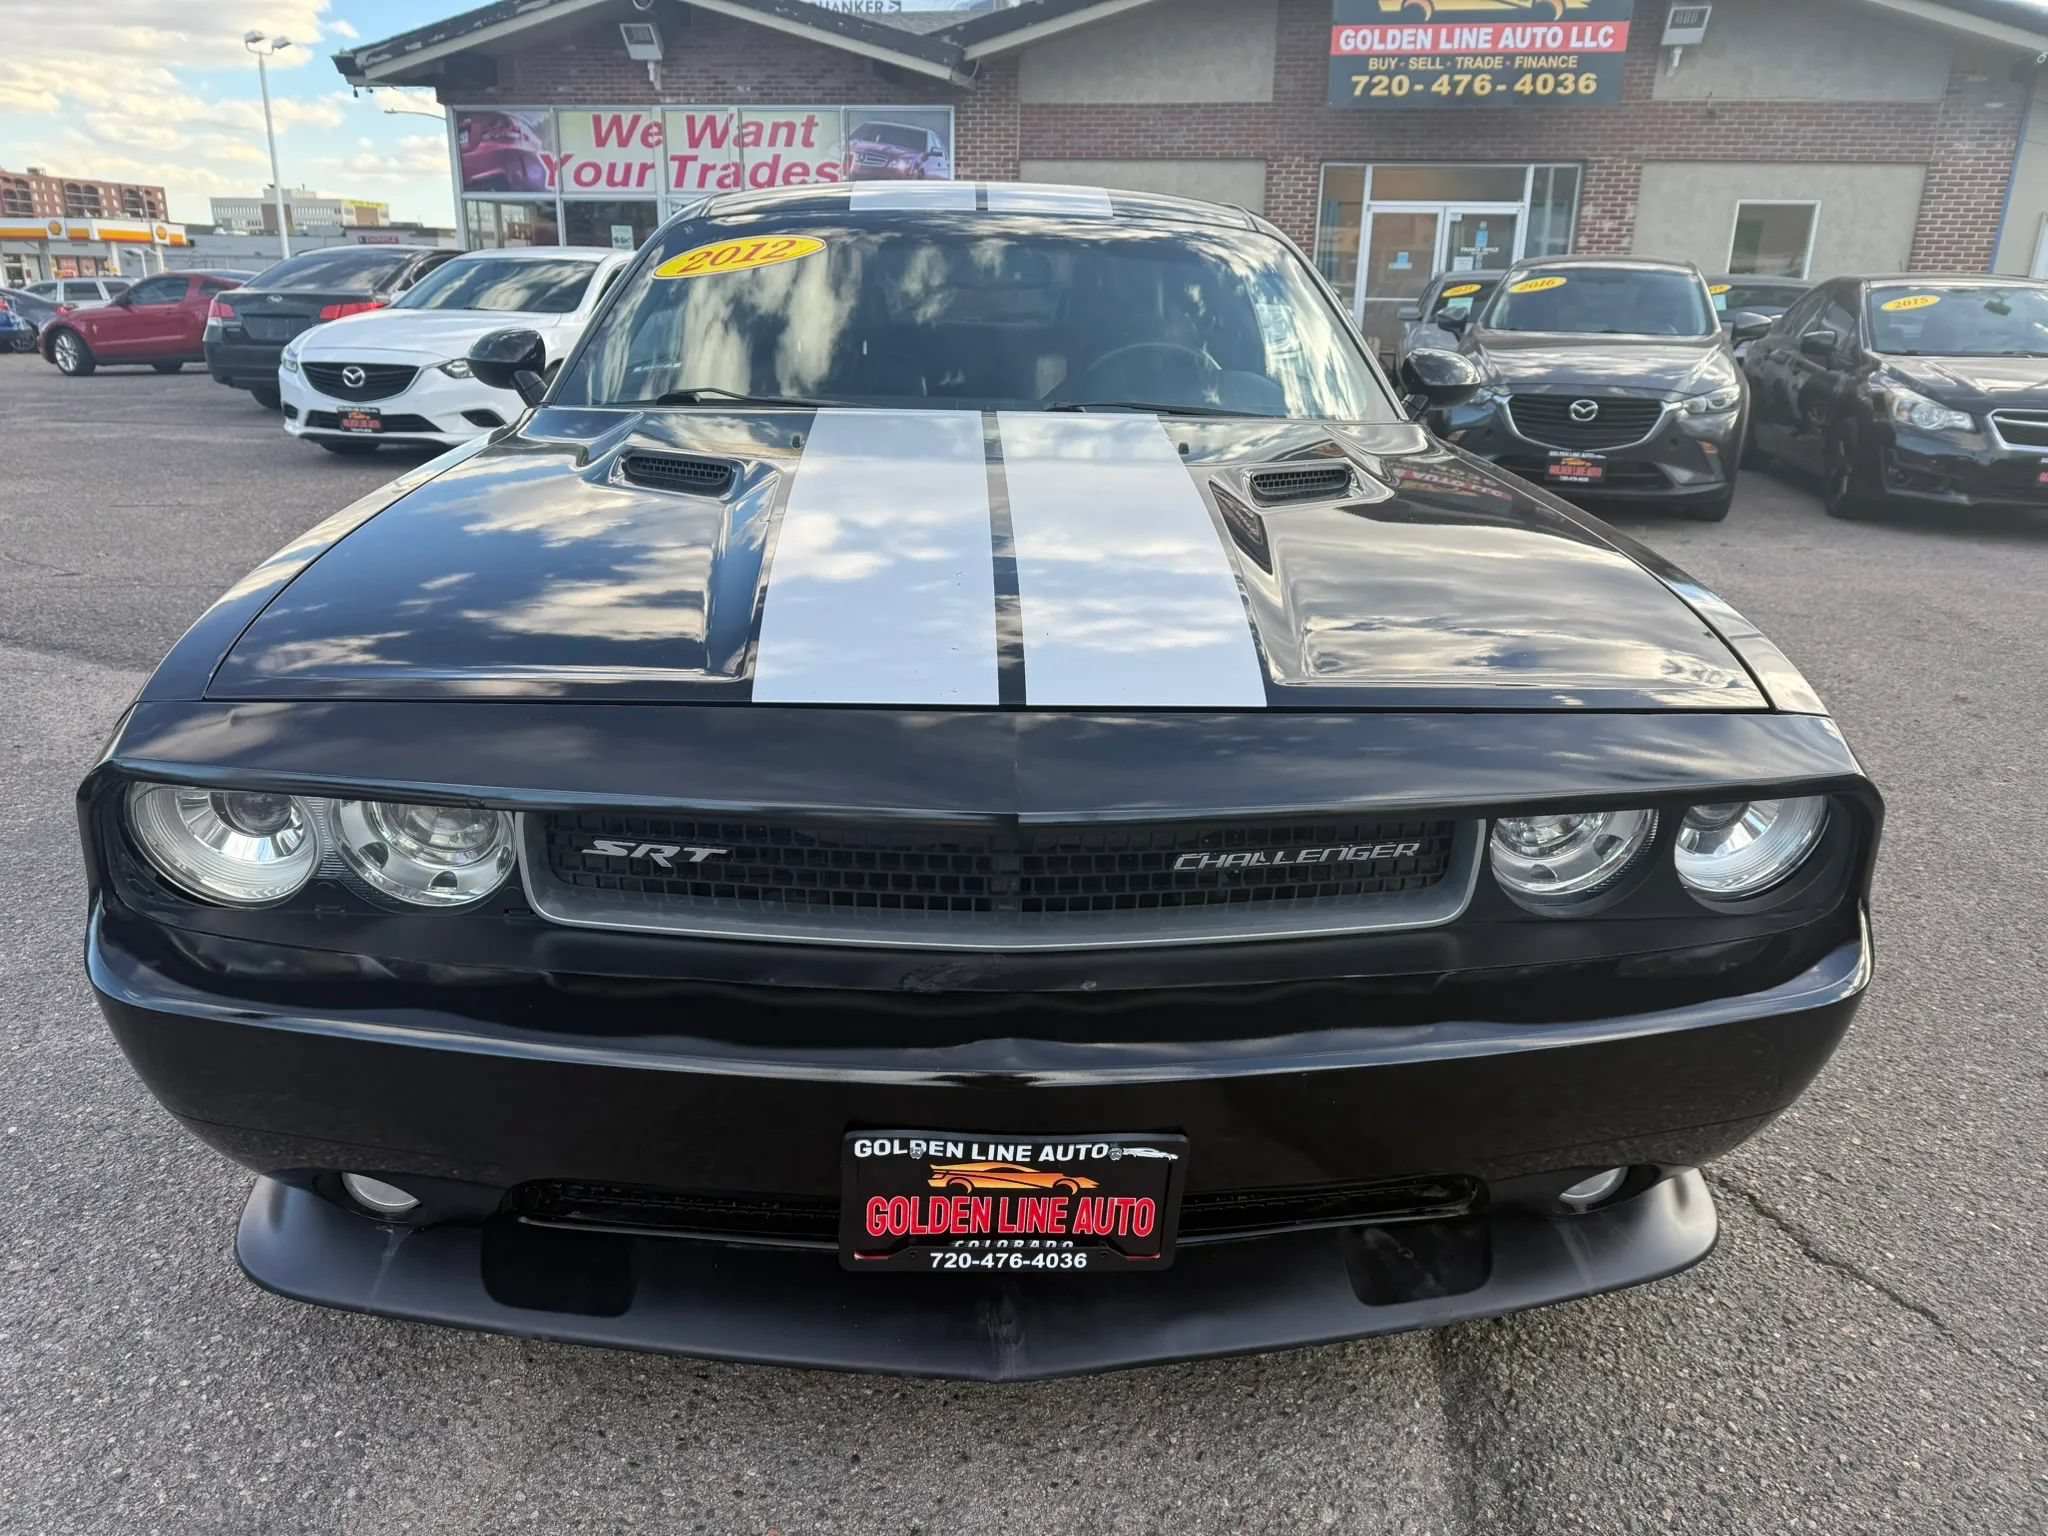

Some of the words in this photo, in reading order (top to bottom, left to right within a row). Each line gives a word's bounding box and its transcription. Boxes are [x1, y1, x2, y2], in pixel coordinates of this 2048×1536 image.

[1340, 28, 1432, 51] GOLDEN
[1439, 27, 1493, 50] LINE
[1498, 26, 1563, 49] AUTO
[1569, 25, 1615, 48] LLC
[1368, 57, 1399, 70] BUY
[1408, 56, 1444, 69] SELL
[1455, 56, 1504, 69] TRADE
[1514, 55, 1578, 68] FINANCE
[592, 113, 664, 149] We
[685, 113, 819, 149] Want
[539, 153, 656, 188] Your
[677, 239, 797, 274] 2012
[1520, 279, 1556, 289] 2016
[1895, 297, 1929, 309] 2015
[581, 840, 729, 867] SRT
[1173, 843, 1421, 870] CHALLENGER
[854, 1139, 964, 1160] GOLDEN
[971, 1143, 1031, 1162] LINE
[1038, 1142, 1110, 1162] AUTO
[866, 1195, 992, 1237] GOLDEN
[998, 1197, 1068, 1234] LINE
[1072, 1197, 1156, 1237] AUTO
[930, 1252, 1088, 1269] 720-476-4036
